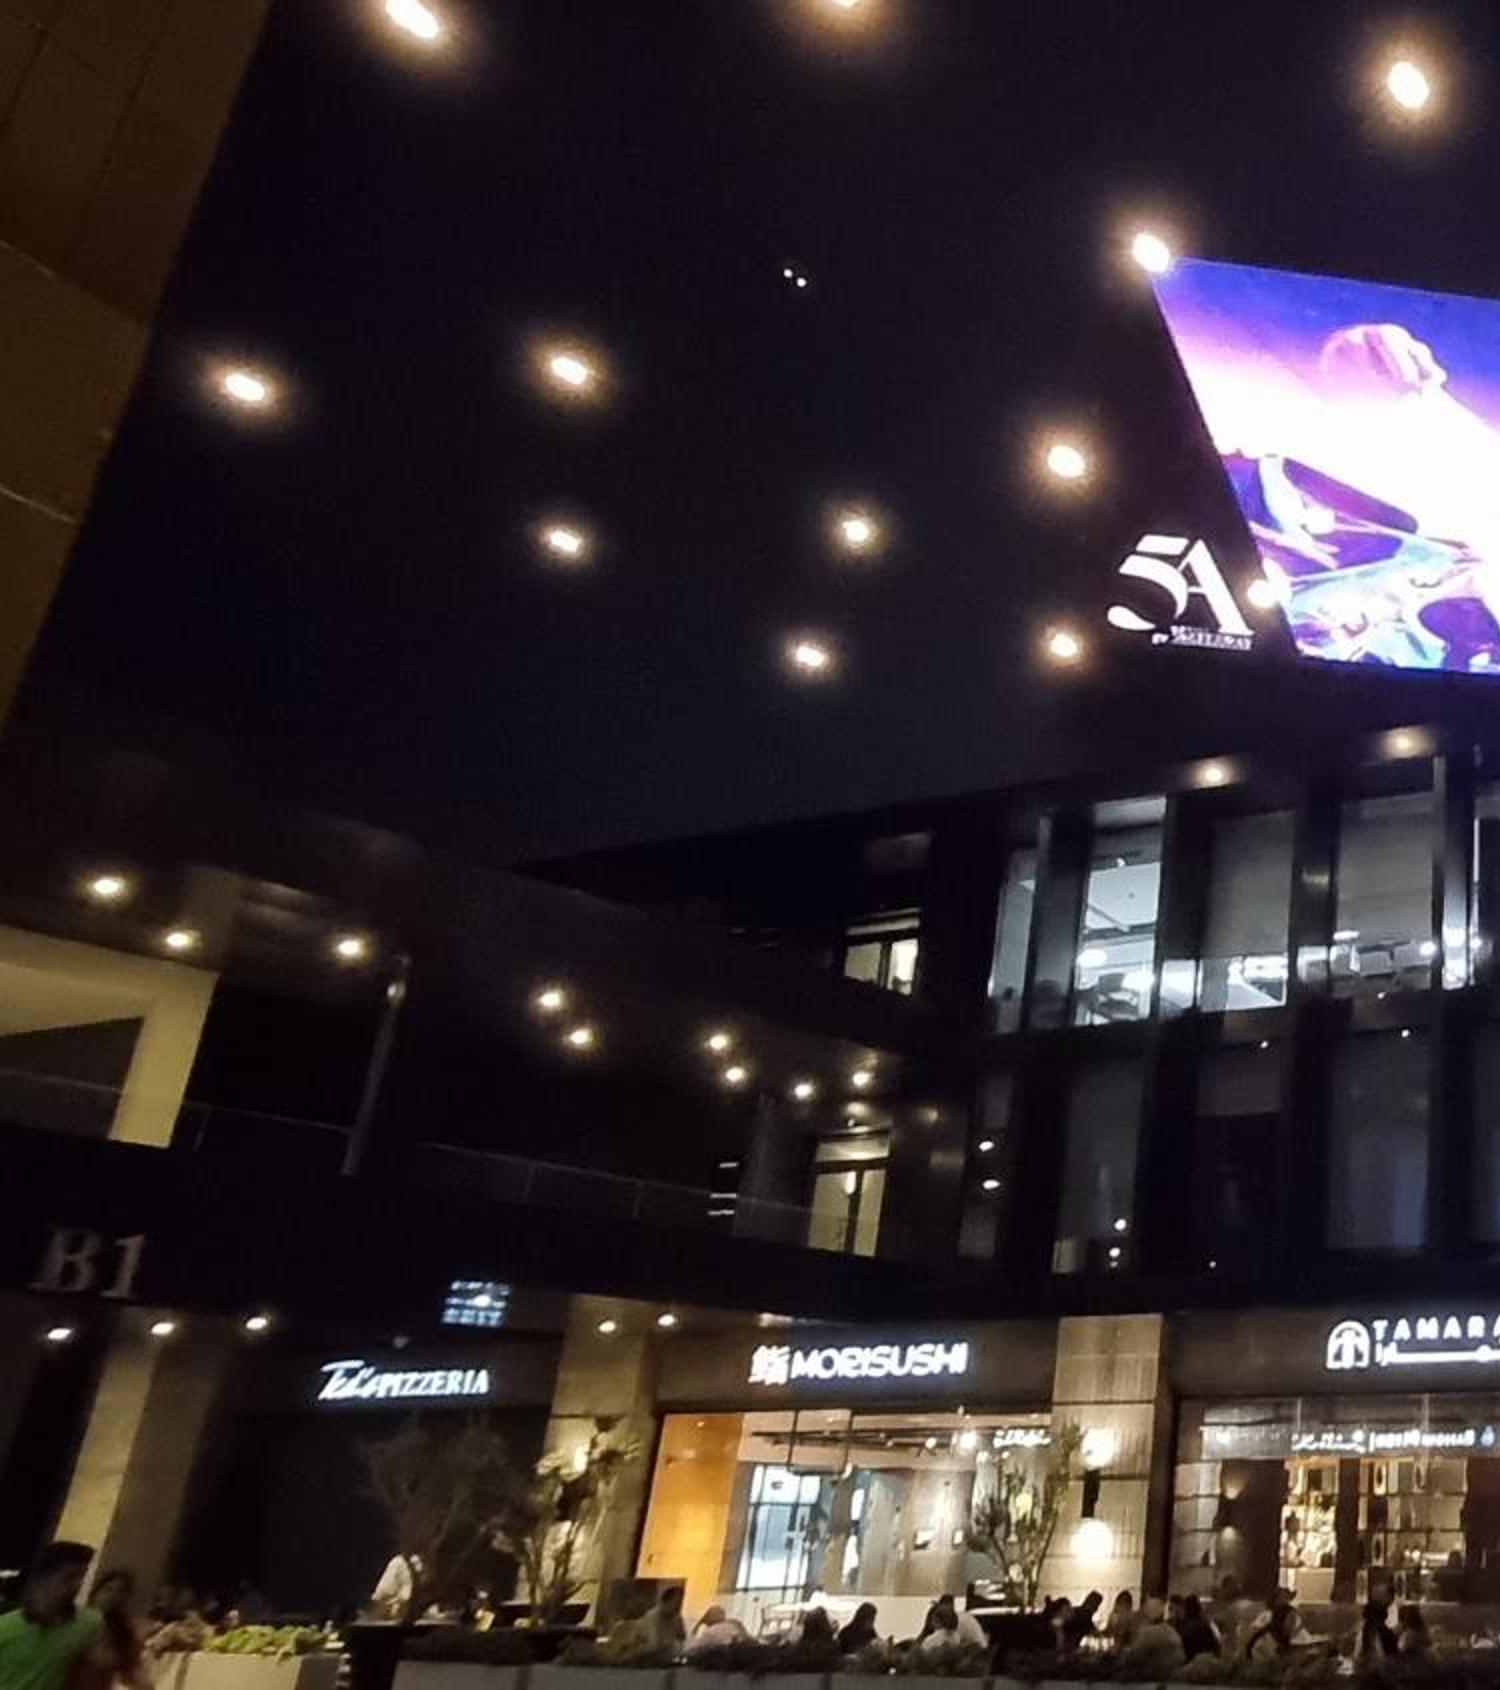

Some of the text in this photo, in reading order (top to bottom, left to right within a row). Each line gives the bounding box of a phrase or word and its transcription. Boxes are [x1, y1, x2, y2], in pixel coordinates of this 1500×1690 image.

[1107, 534, 1255, 631] 5A
[30, 1227, 146, 1298] B1
[375, 1369, 489, 1398] PIZZERIA
[790, 1342, 968, 1379] MORISUSHI
